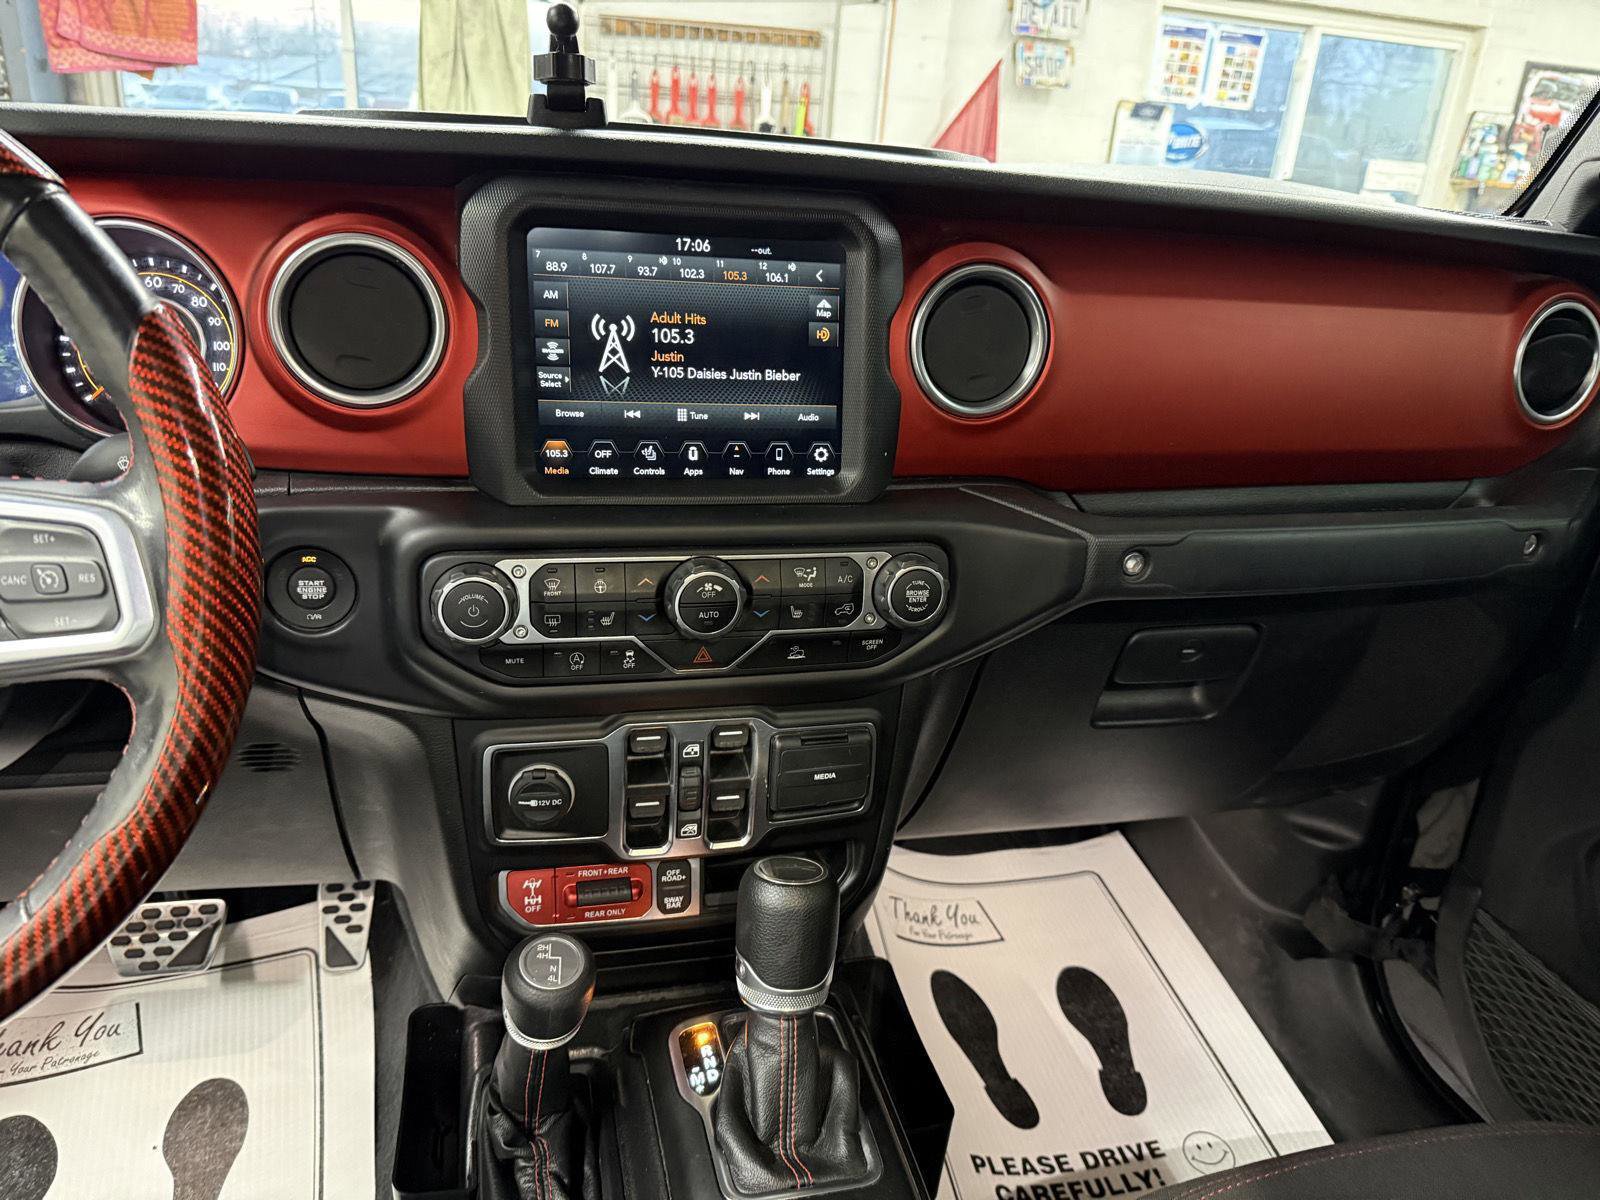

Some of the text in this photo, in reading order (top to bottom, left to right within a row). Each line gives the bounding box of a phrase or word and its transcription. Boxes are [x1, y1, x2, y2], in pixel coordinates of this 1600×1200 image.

[675, 238, 711, 253] 17:06
[535, 250, 541, 258] 7
[581, 252, 588, 261] 8
[627, 254, 633, 263] 9
[545, 260, 568, 272] 88.9
[672, 257, 682, 266] 10
[716, 260, 724, 268] 11
[758, 262, 768, 270] 12
[589, 263, 616, 275] 107.7
[637, 266, 658, 277] 93.7
[680, 268, 705, 279] 102.3
[723, 270, 748, 281] 105.3
[765, 272, 789, 283] 106.1
[145, 277, 163, 289] 60
[172, 284, 186, 294] 70
[543, 290, 559, 300] AM
[191, 296, 208, 308] 80
[650, 312, 707, 325] Adult Hits
[816, 309, 832, 319] Map
[208, 317, 222, 327] 90
[544, 318, 559, 328] FM
[651, 328, 695, 345] 105.3
[213, 341, 231, 351] 100
[650, 351, 684, 363] Justin
[212, 362, 227, 372] 110
[538, 371, 563, 379] Source
[650, 367, 801, 382] Y-105 Daisies Justin Bieber
[540, 380, 562, 388] Select
[555, 409, 585, 419] Browse
[690, 411, 709, 421] Tune
[797, 413, 819, 422] Audio
[545, 449, 568, 458] 105.3
[594, 450, 612, 459] OFF
[544, 467, 569, 476] Media
[589, 467, 619, 476] Climate
[633, 467, 666, 476] Controls
[683, 467, 703, 477] Apps
[729, 467, 744, 476] Nav
[767, 467, 791, 476] Phone
[806, 467, 835, 477] Settings
[2, 574, 27, 586] CANC
[78, 572, 96, 584] RES
[837, 574, 854, 583] A/C
[460, 593, 486, 602] VOLUME
[701, 591, 716, 599] OFF
[698, 611, 720, 619] AUTO
[505, 657, 525, 665] MUTE
[813, 771, 837, 781] MEDIA
[551, 798, 562, 806] DC
[661, 873, 686, 882] ROAD+
[666, 868, 681, 877] OFF
[663, 896, 684, 904] SWAY
[524, 904, 542, 914] OFF
[666, 901, 682, 910] BAR
[584, 908, 626, 918] REAR ONLY
[888, 896, 980, 928] Thank You
[547, 974, 558, 982] 4L
[74, 1011, 121, 1048] You
[10, 1049, 101, 1076] Your Patronage
[704, 1056, 717, 1069] N
[707, 1068, 719, 1084] D
[970, 1139, 1167, 1176] PLEASE DRIVE
[995, 1167, 1167, 1200] CAREFULLY!
